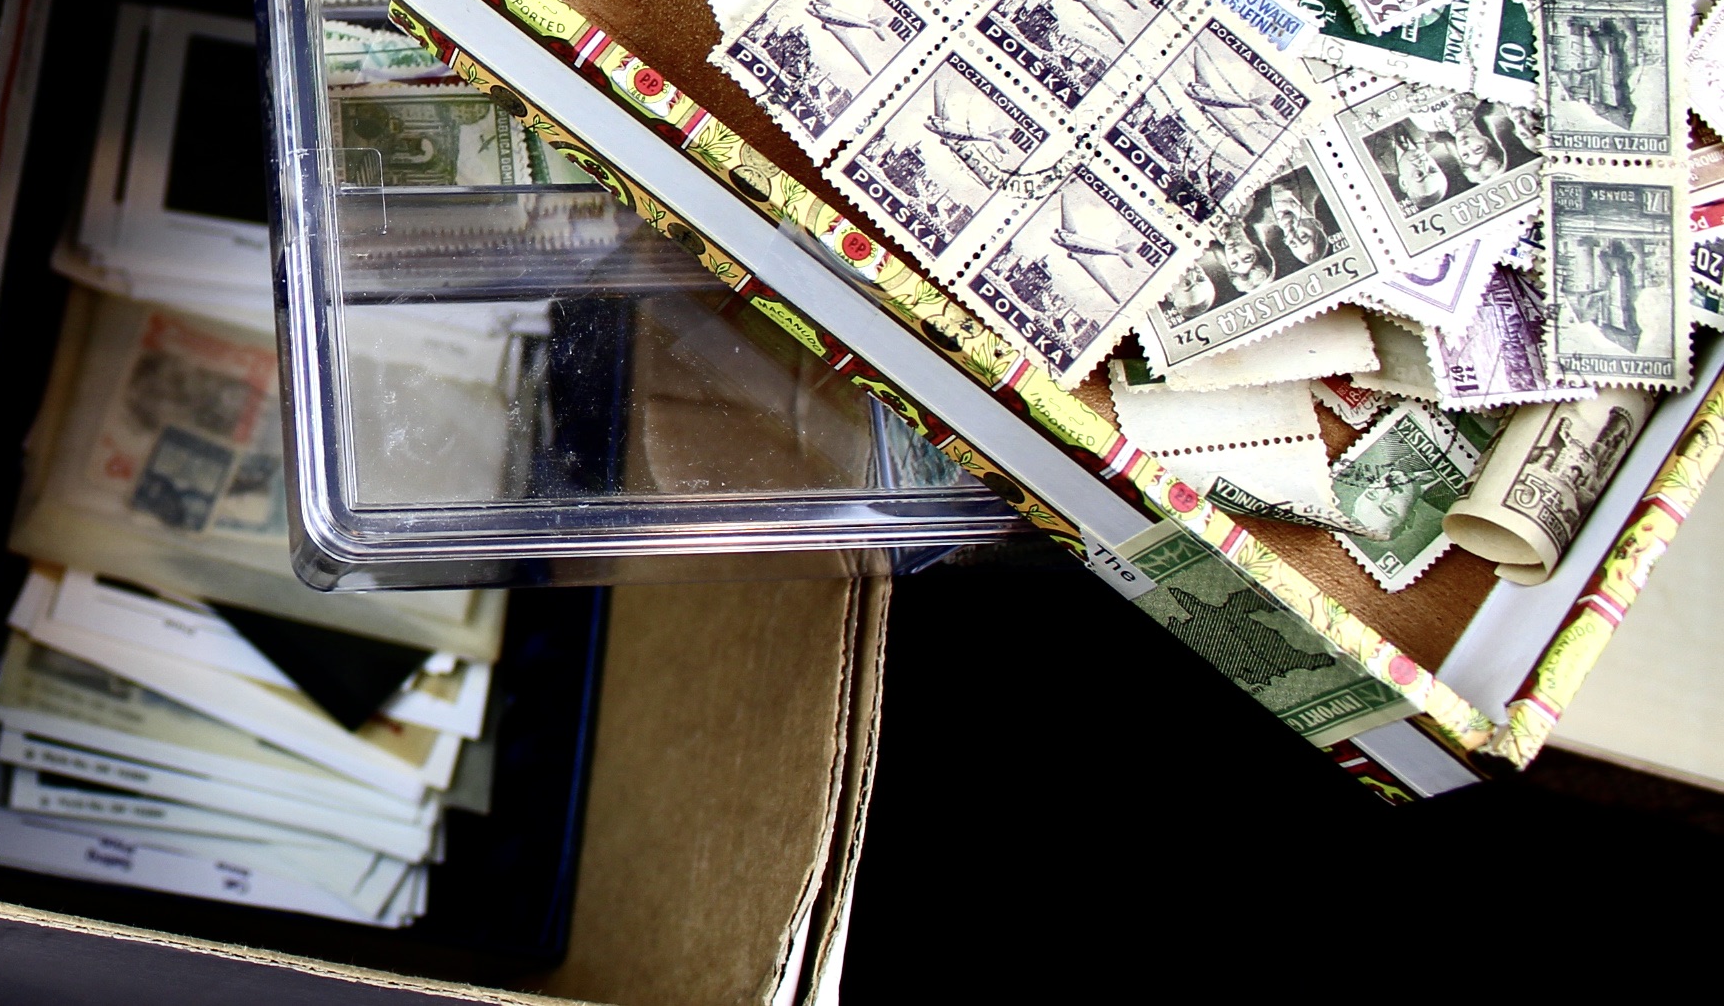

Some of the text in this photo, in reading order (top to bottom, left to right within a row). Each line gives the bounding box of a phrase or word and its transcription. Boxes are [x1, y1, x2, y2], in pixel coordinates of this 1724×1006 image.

[984, 25, 1072, 105] POLSKA
[1209, 20, 1306, 107] POCZTA LOTNICZA
[1499, 43, 1526, 73] 10
[736, 49, 819, 132] POLSKA
[948, 54, 1046, 140] POCZTA LOTNICZA
[1553, 135, 1668, 151] POCZTA POLSKA
[851, 167, 938, 250] POLSKA
[1077, 167, 1121, 208] POCZTA
[1119, 201, 1174, 253] LOTNICZA
[1450, 173, 1537, 225] OLSKA
[756, 299, 823, 352] MACANUDO
[978, 282, 1065, 365] POLSKA
[1216, 273, 1322, 336] POLSKA
[1560, 357, 1672, 375] POCZTA POLSKA
[1030, 392, 1097, 448] IMPORTED
[1397, 418, 1441, 469] POLSKA
[1094, 543, 1137, 584] The
[1377, 553, 1403, 577] 15
[1545, 620, 1597, 692] MACANUDO
[1306, 695, 1363, 729] IMPORT
